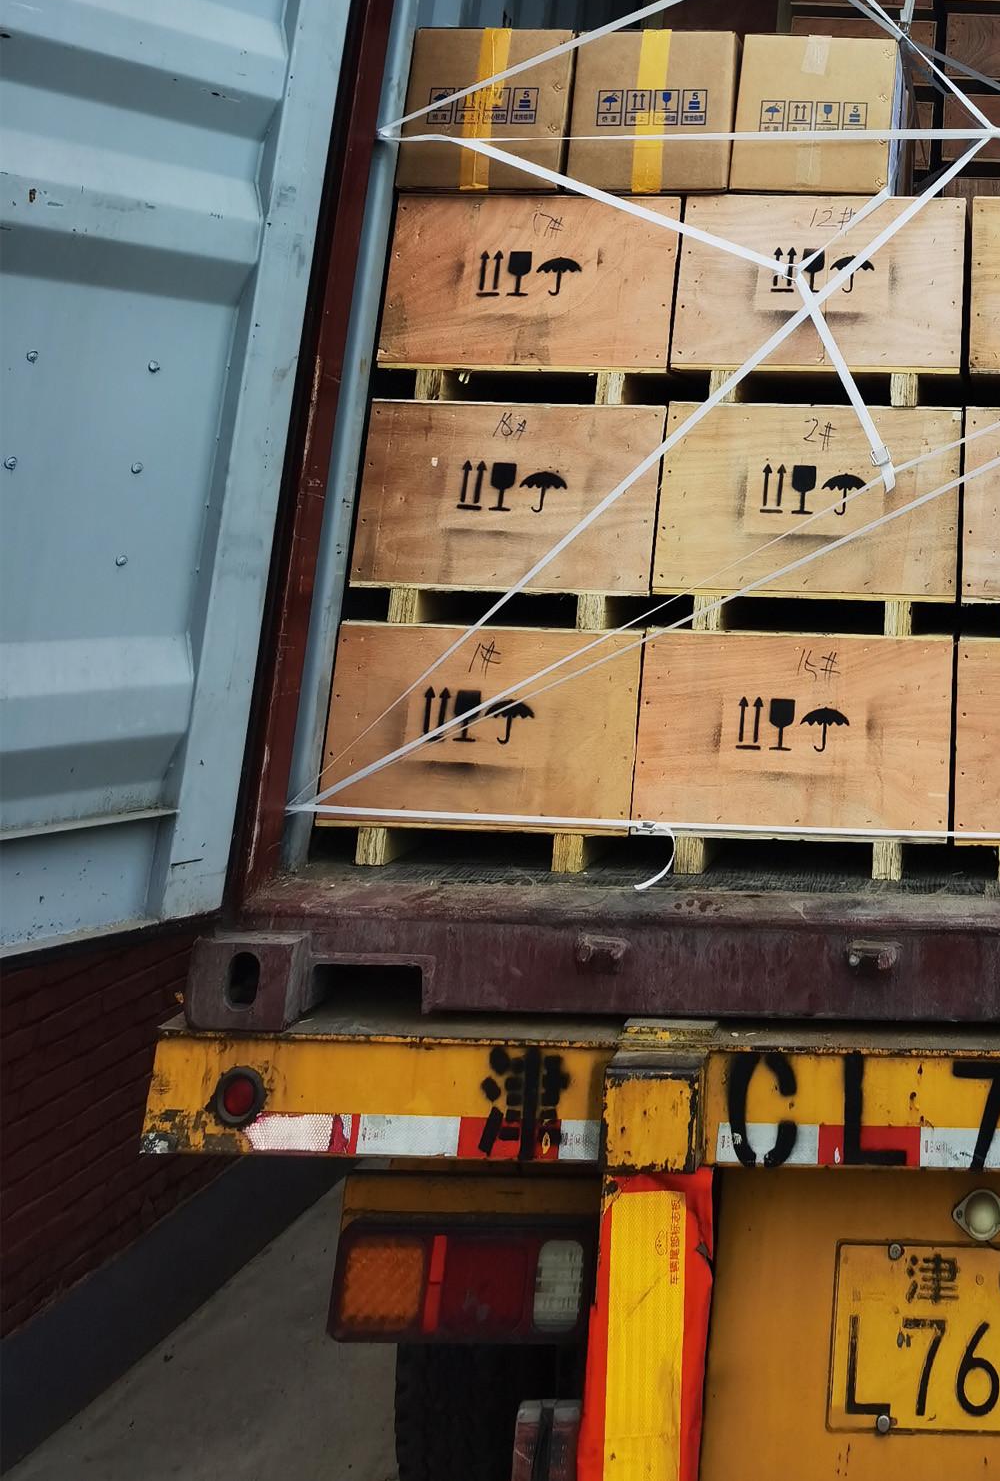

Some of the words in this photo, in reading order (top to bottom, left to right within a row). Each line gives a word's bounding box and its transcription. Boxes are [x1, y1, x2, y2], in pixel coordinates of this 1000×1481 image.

[523, 90, 530, 99] 5
[692, 92, 699, 100] 5
[852, 105, 859, 113] 5
[809, 206, 857, 231] 12#
[803, 418, 838, 451] 2#
[468, 639, 502, 680] 1#
[796, 648, 841, 685] 15#
